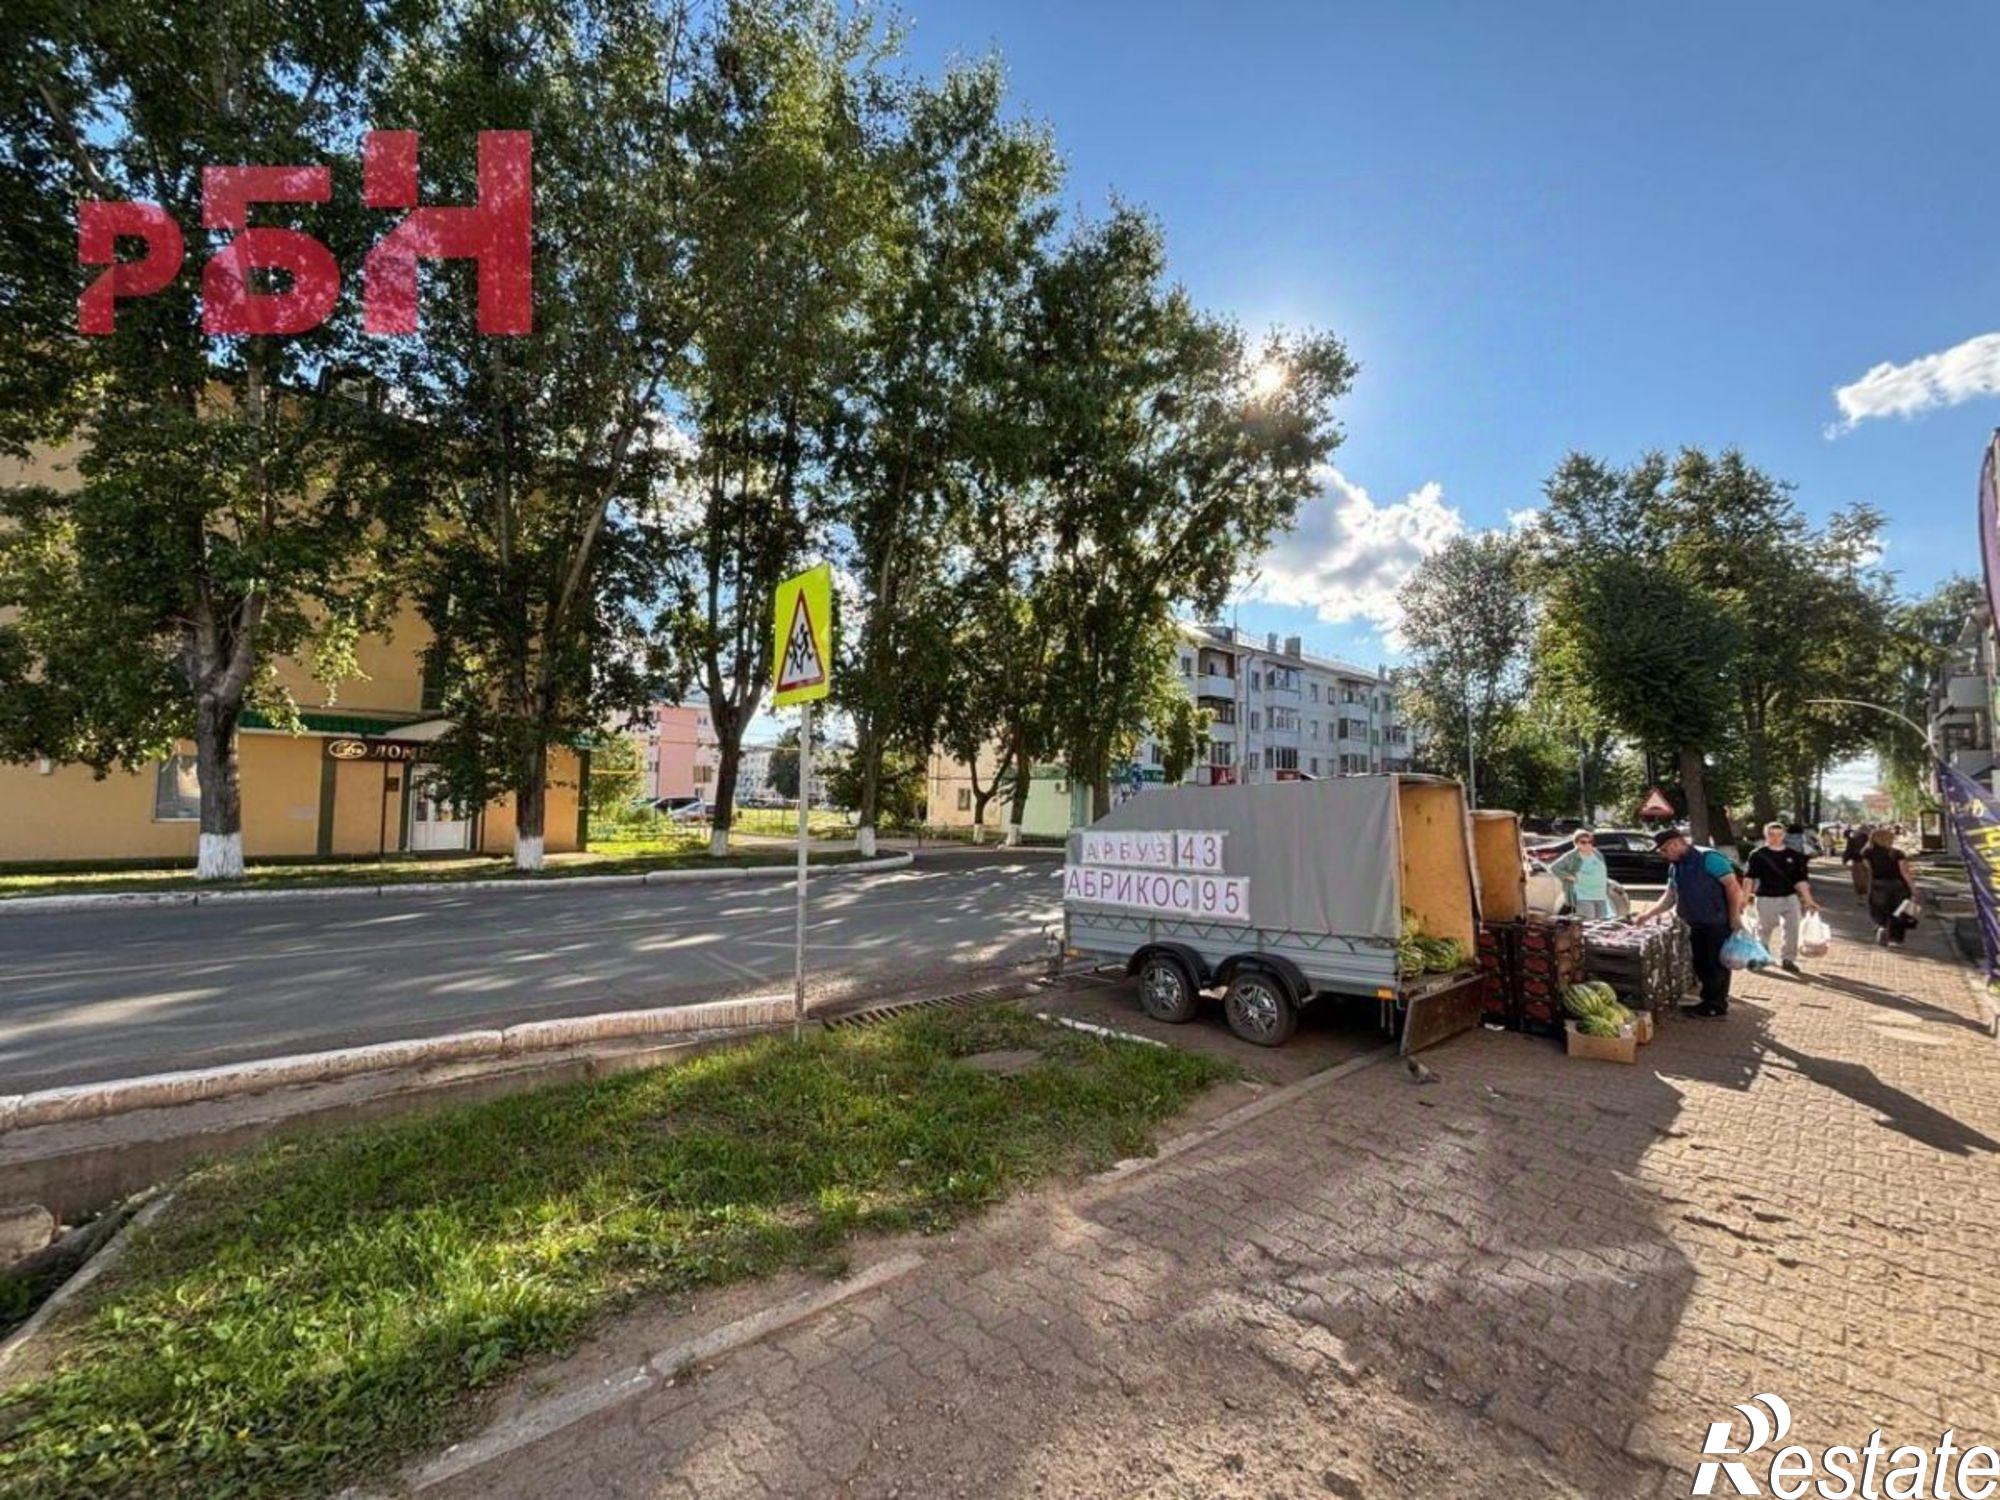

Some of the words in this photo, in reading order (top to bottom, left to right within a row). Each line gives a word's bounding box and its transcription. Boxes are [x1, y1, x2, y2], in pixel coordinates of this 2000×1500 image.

[1086, 842, 1168, 864] АРБУЗ
[1181, 836, 1217, 868] 43
[1066, 868, 1190, 909] АБРИКОС
[1202, 880, 1240, 914] 95
